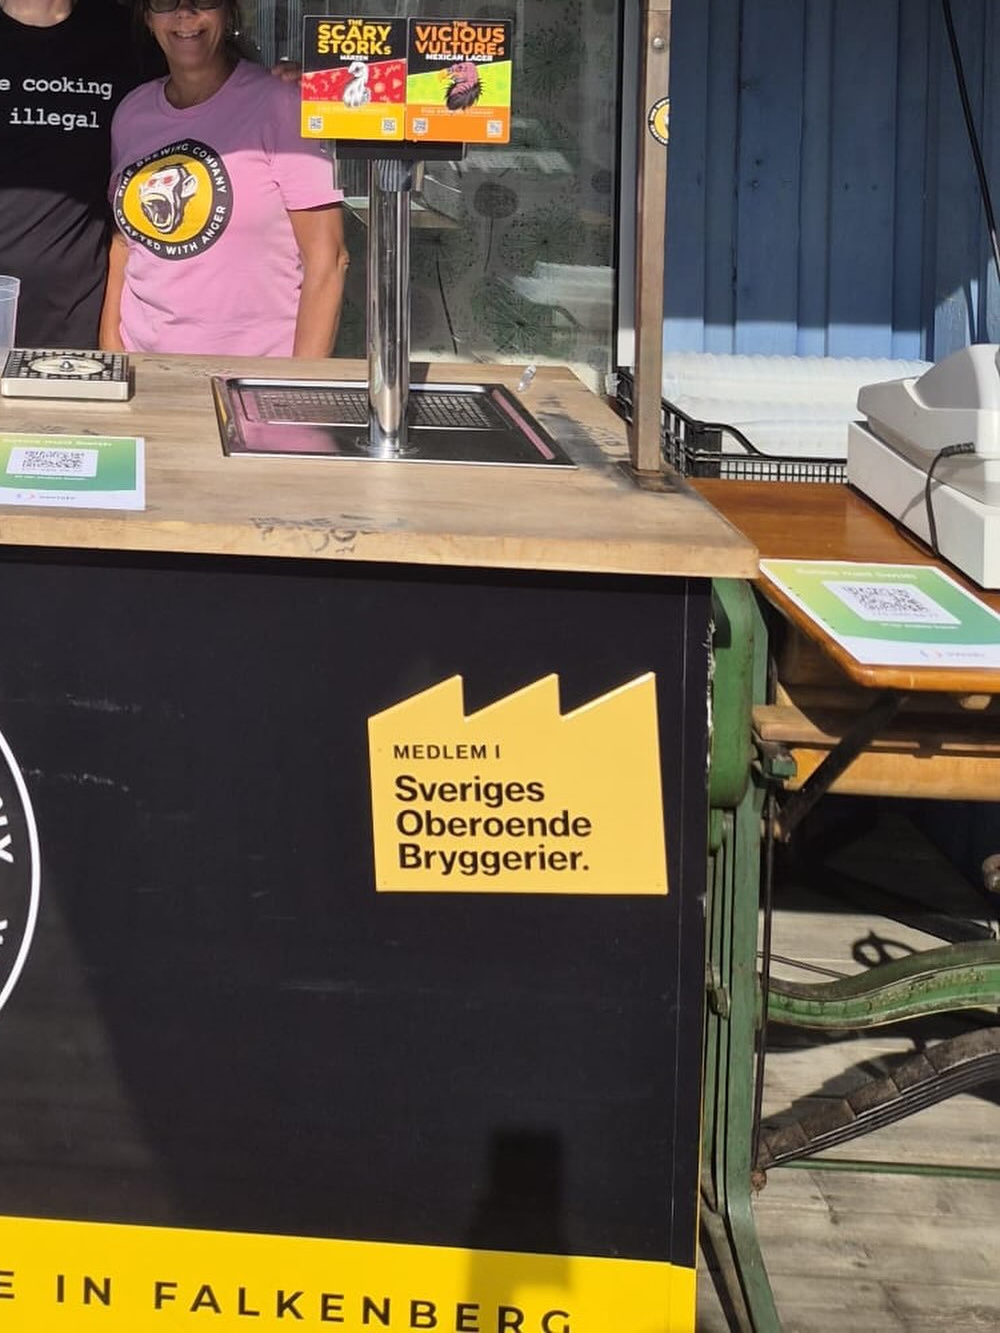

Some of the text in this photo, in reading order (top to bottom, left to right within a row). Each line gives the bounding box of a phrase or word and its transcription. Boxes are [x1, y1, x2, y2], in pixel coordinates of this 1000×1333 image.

[317, 24, 392, 42] SCARY
[415, 25, 505, 42] VICIOUS
[22, 77, 112, 99] cooking
[9, 108, 99, 131] illegal
[192, 146, 227, 193] COMPANY
[165, 241, 199, 256] WITH
[200, 205, 228, 245] ANGER
[393, 744, 501, 760] MEDLEM I
[394, 774, 545, 808] Sveriges
[396, 809, 593, 838] Oberoende
[397, 842, 590, 877] Bryggerier.
[56, 1273, 112, 1307] IN
[153, 1281, 571, 1333] FALKENBERG
